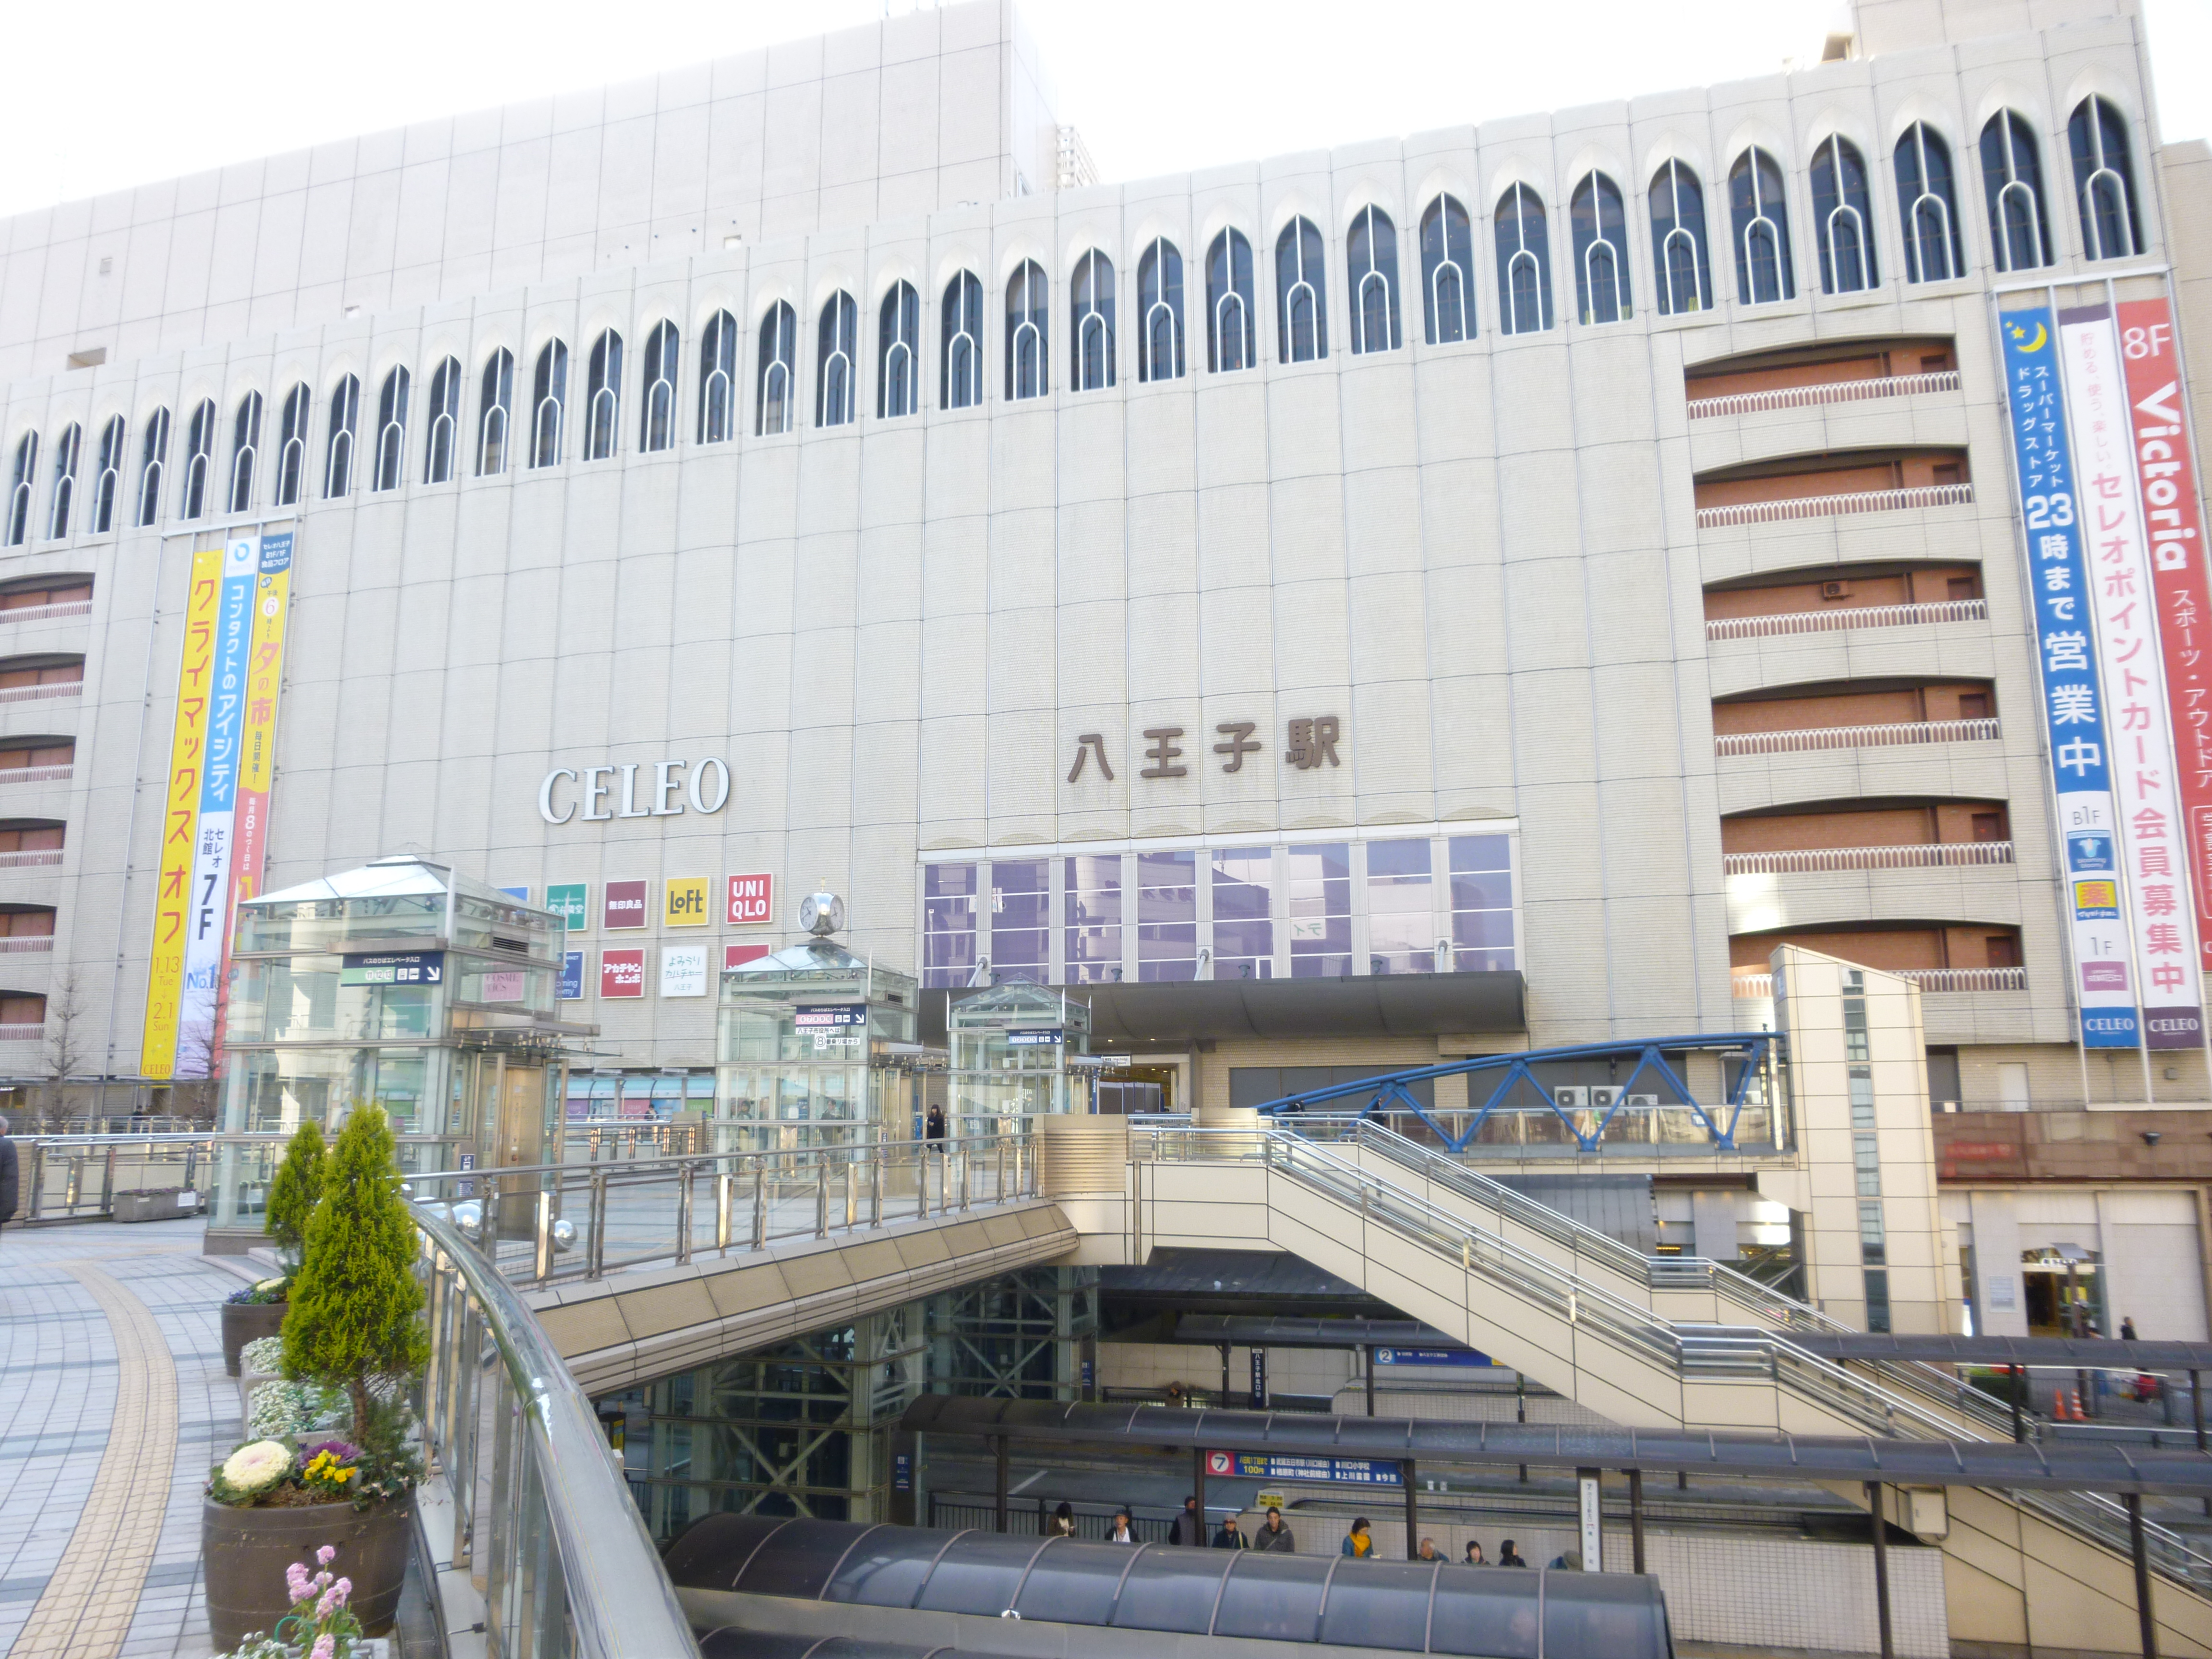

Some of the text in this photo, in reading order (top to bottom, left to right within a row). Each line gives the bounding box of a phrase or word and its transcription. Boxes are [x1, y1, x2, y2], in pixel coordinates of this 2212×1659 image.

[2124, 323, 2170, 360] 8F
[2018, 367, 2043, 488] ドラッグストア
[2034, 365, 2063, 488] スーパーマーケット
[2134, 380, 2196, 572] Victoria
[210, 585, 245, 802] コンタクトのアイシティ
[2092, 472, 2186, 994] セレオポイントカード会員募集中
[1067, 716, 1340, 783] 八王子駅
[162, 578, 215, 944] クライマックスオフ
[538, 756, 730, 825] CELEO
[2073, 805, 2100, 826] B1F
[202, 828, 214, 855] 北館
[212, 828, 225, 868] セレオ
[733, 879, 764, 897] UNI
[2080, 883, 2110, 906] 薬
[609, 898, 643, 911] 無印良品
[731, 900, 767, 920] QLO
[2091, 937, 2113, 956] 1F
[668, 955, 701, 967] よみうり
[158, 975, 174, 986] Tue
[665, 968, 703, 979] カルチャー
[153, 1020, 169, 1032] Sun
[2085, 1017, 2134, 1031] CELEO
[2148, 1018, 2199, 1032] CELEO
[144, 1063, 171, 1075] CELEO
